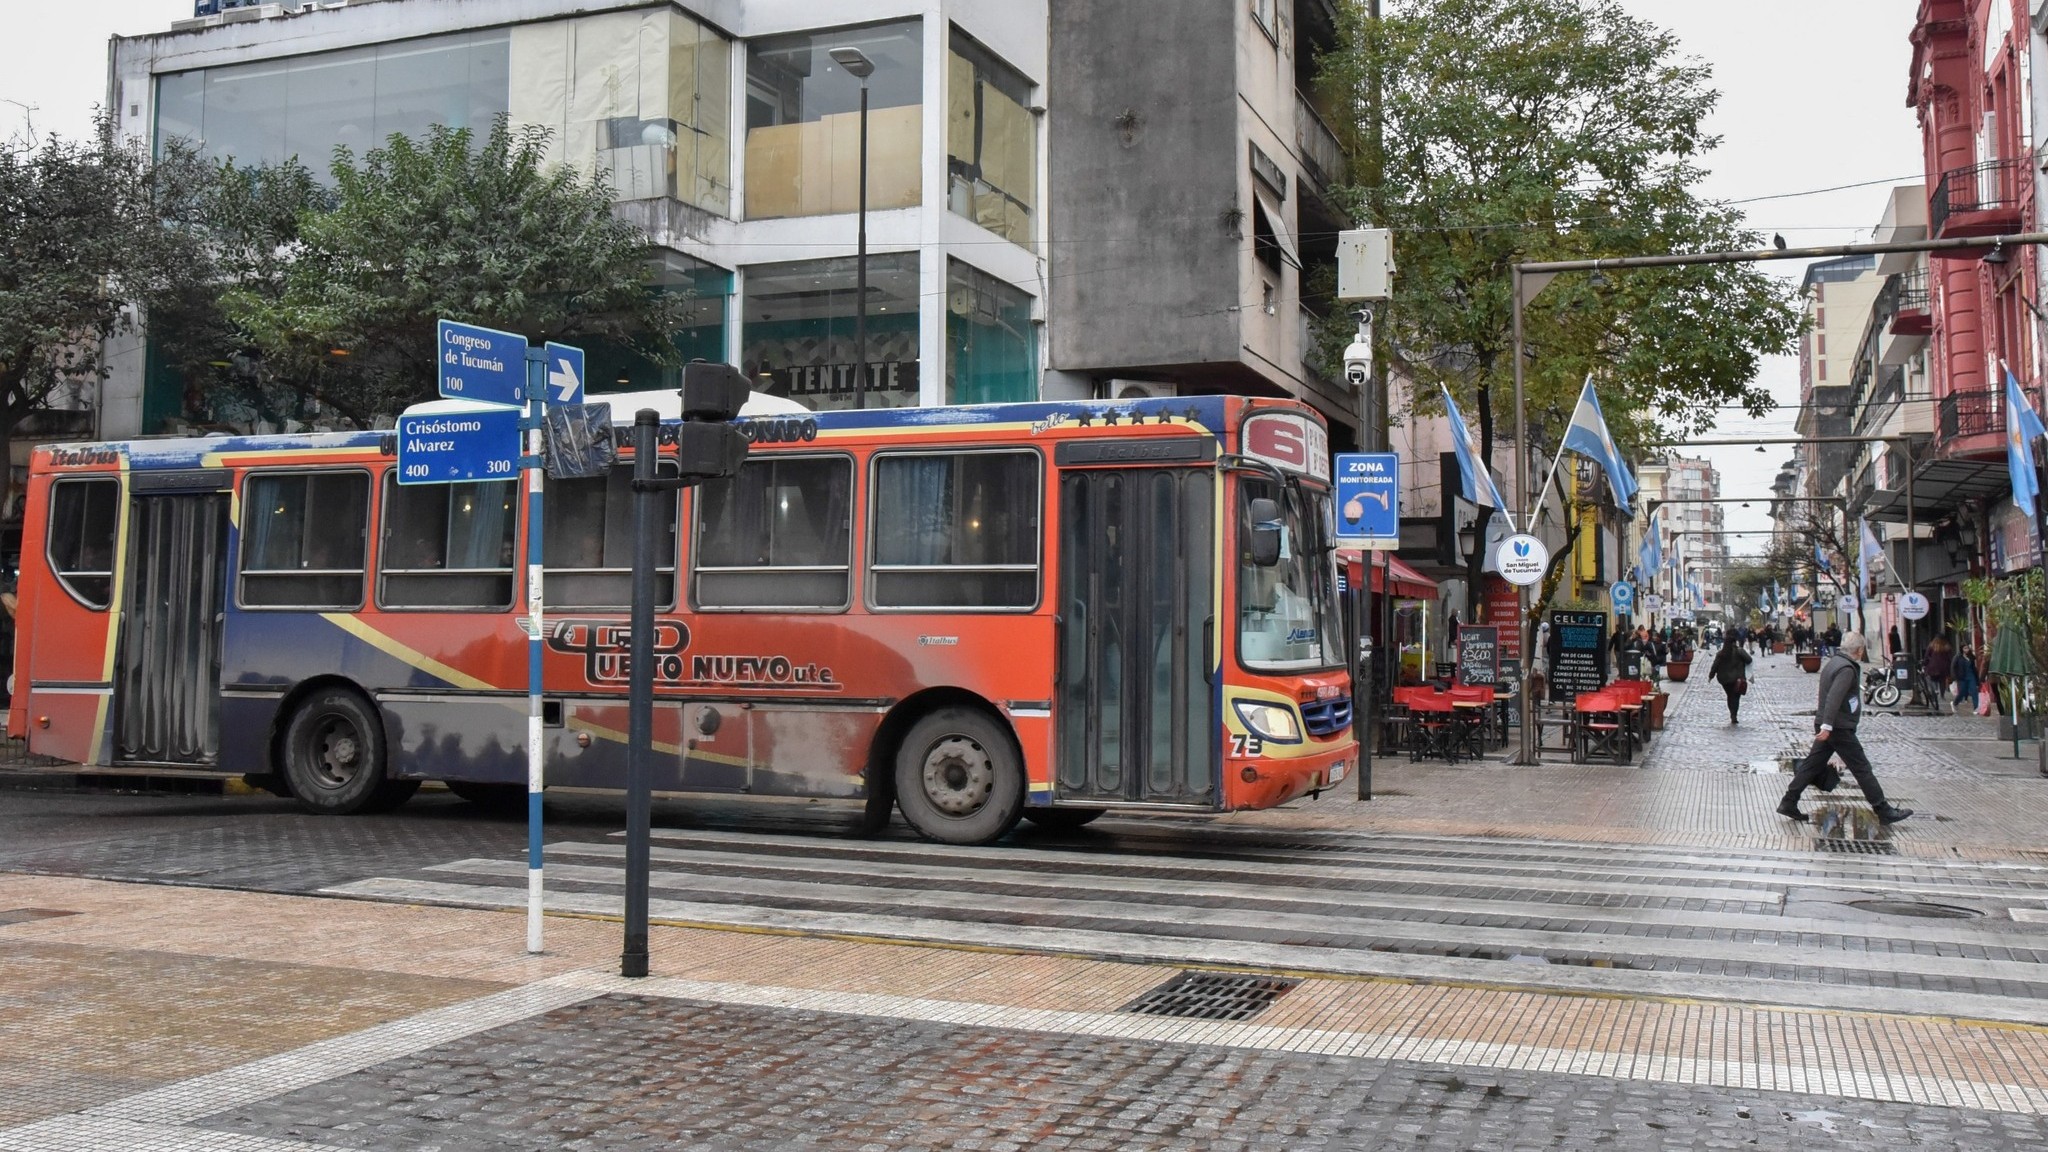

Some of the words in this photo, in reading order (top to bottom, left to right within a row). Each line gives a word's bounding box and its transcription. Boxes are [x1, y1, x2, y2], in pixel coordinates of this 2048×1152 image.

[445, 329, 491, 351] Congreso
[445, 349, 458, 365] de
[460, 352, 504, 372] Tucumán
[445, 376, 463, 391] 100
[514, 389, 521, 400] 0
[406, 419, 481, 435] Crisóstomo
[738, 420, 817, 443] ONADO
[1031, 412, 1070, 435] bello
[406, 439, 455, 453] Alvarez
[51, 449, 119, 466] Italbus
[405, 464, 429, 477] 400
[486, 460, 511, 473] 300
[1349, 462, 1384, 472] ZONA
[692, 656, 791, 683] NUEVO
[1229, 734, 1263, 757] 73
